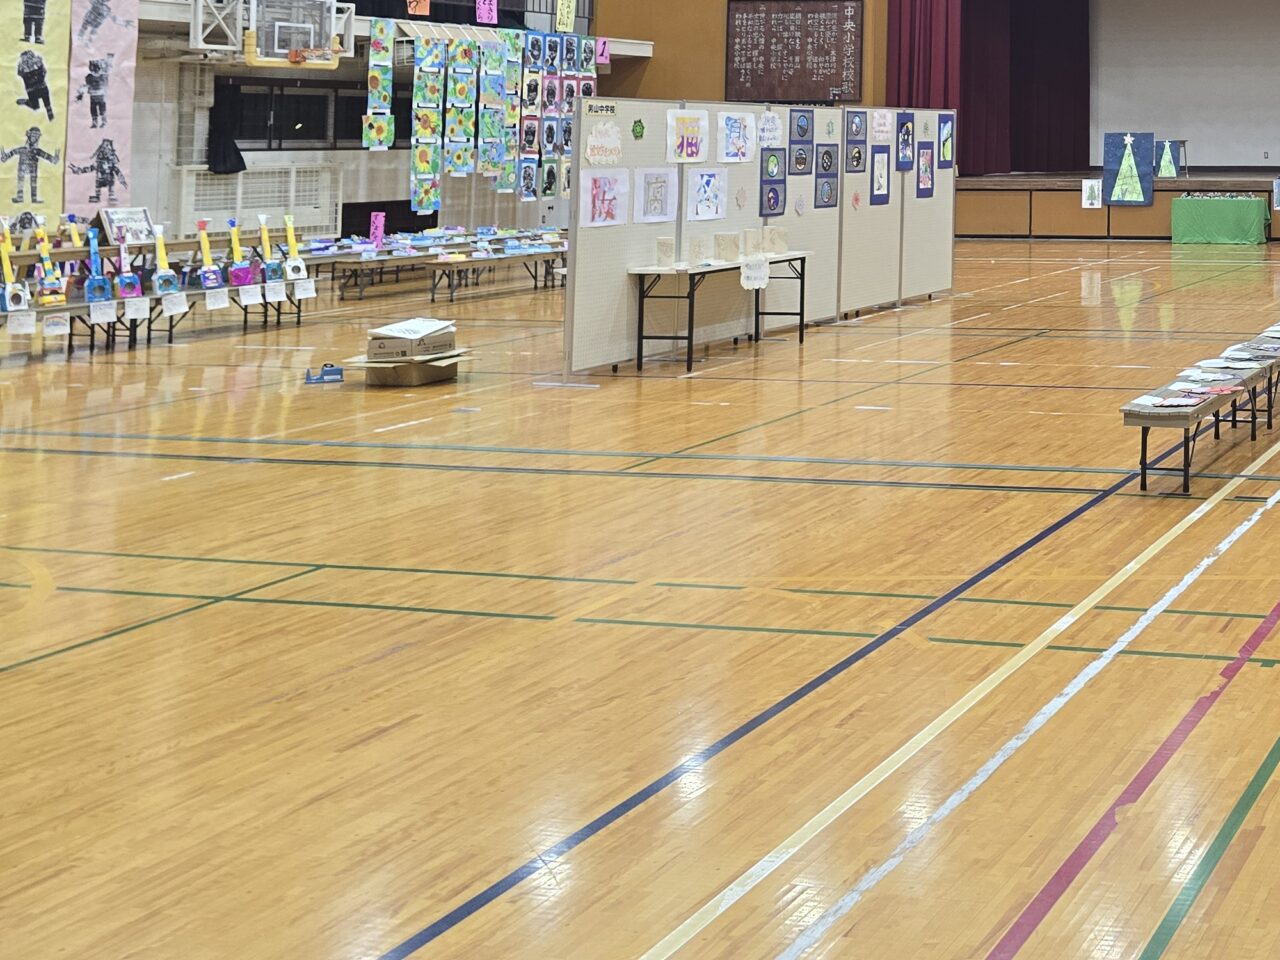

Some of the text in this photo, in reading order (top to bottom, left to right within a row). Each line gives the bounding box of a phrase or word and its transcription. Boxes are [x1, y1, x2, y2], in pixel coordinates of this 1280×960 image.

[842, 6, 856, 94] 中央小学校校歌
[588, 104, 616, 114] 男山中学校
